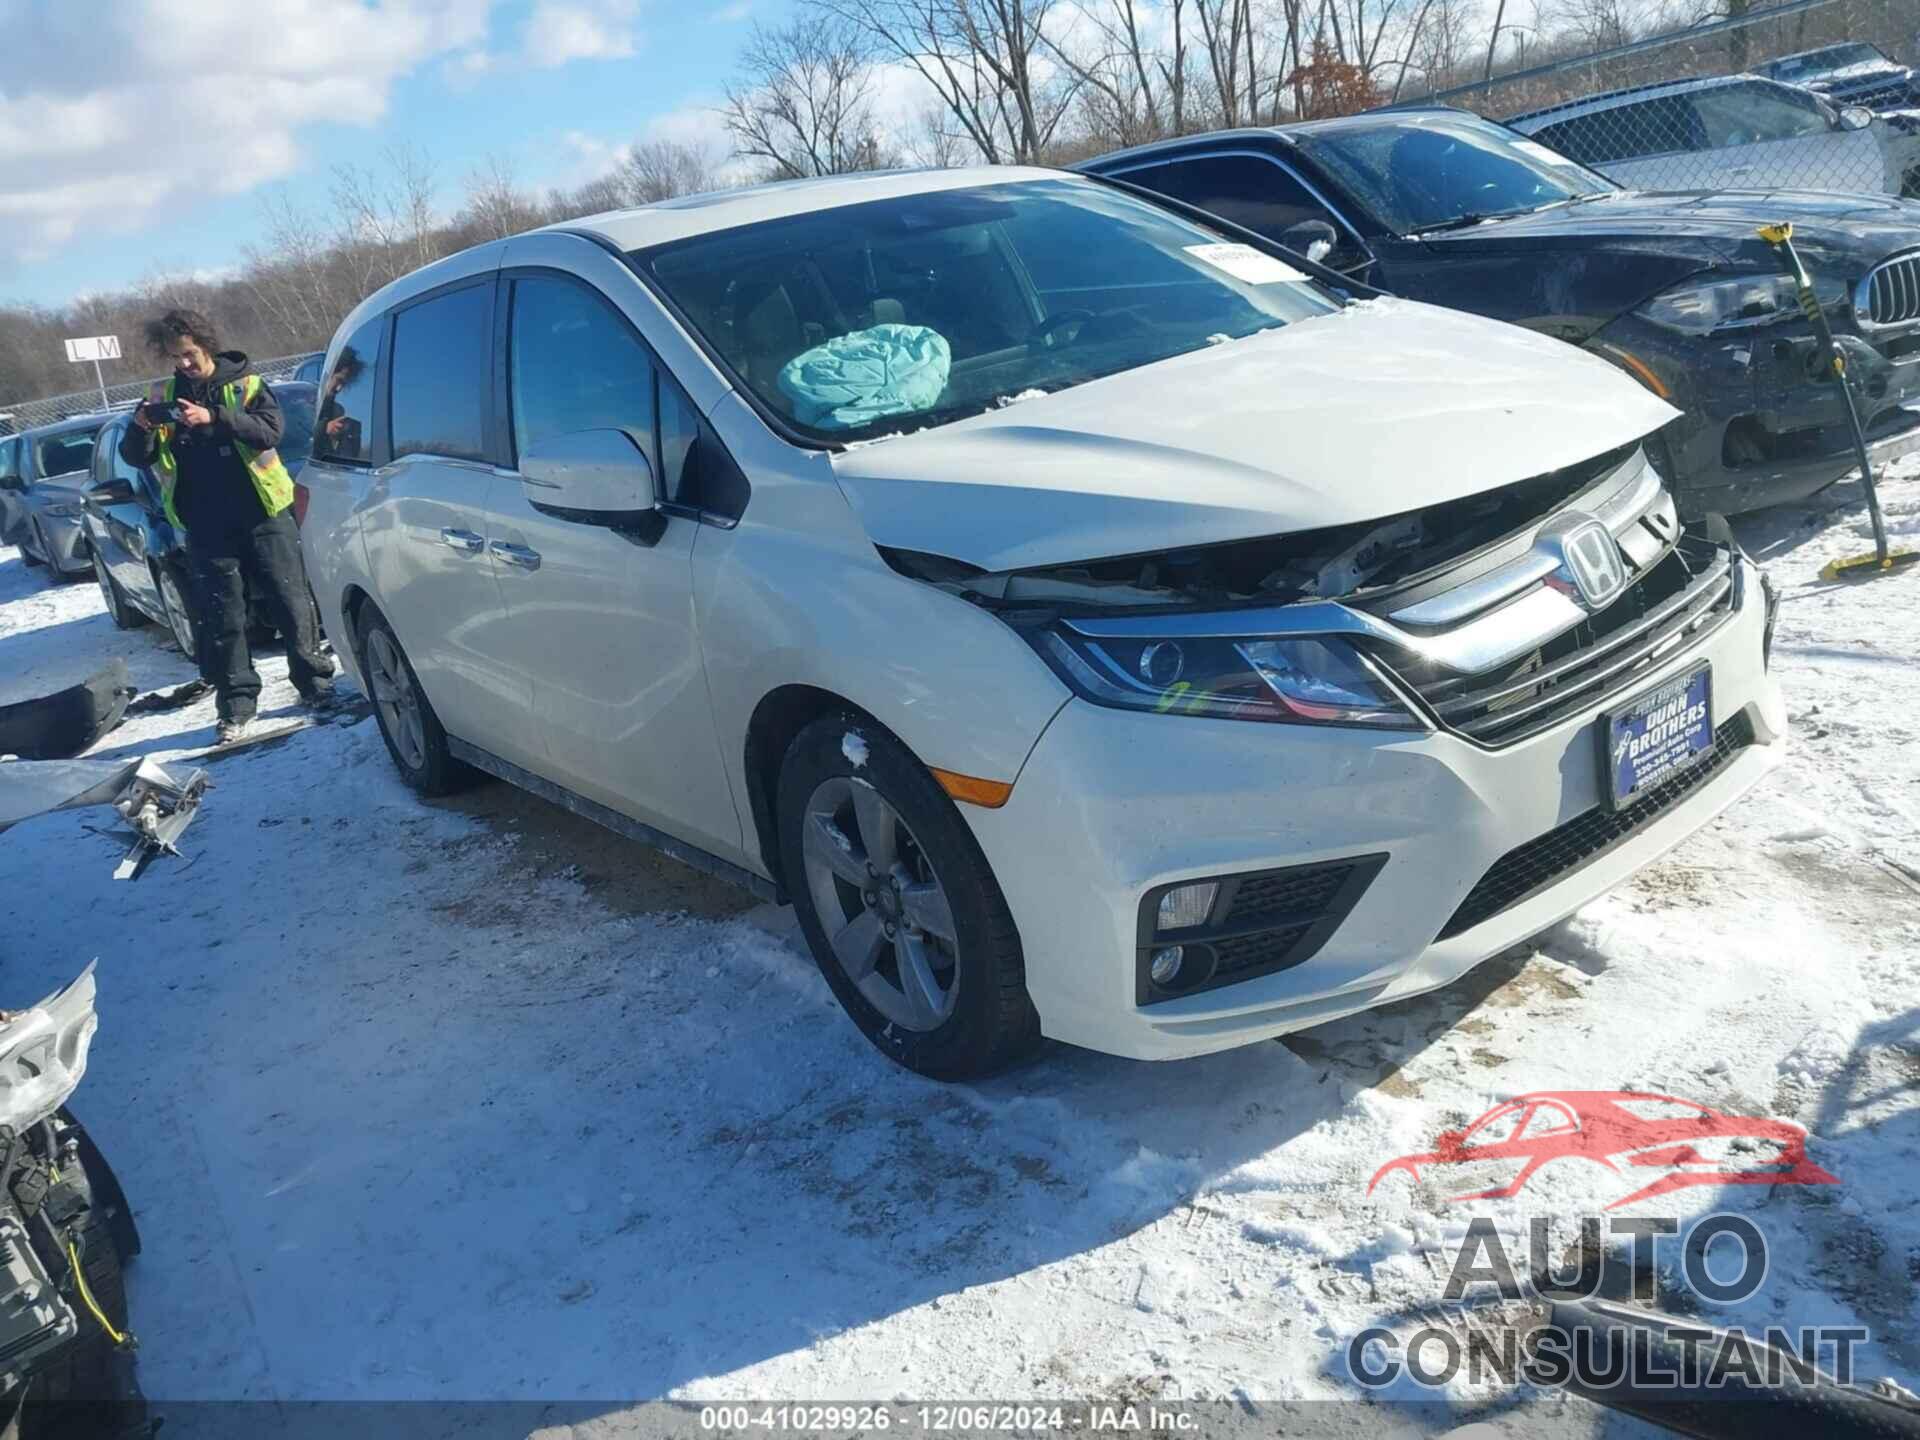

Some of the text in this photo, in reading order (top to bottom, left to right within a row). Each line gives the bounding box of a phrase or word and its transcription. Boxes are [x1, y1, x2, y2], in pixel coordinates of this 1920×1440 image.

[71, 337, 119, 360] L M
[1629, 701, 1706, 759] BROTHERS
[1646, 693, 1688, 731] DUNN
